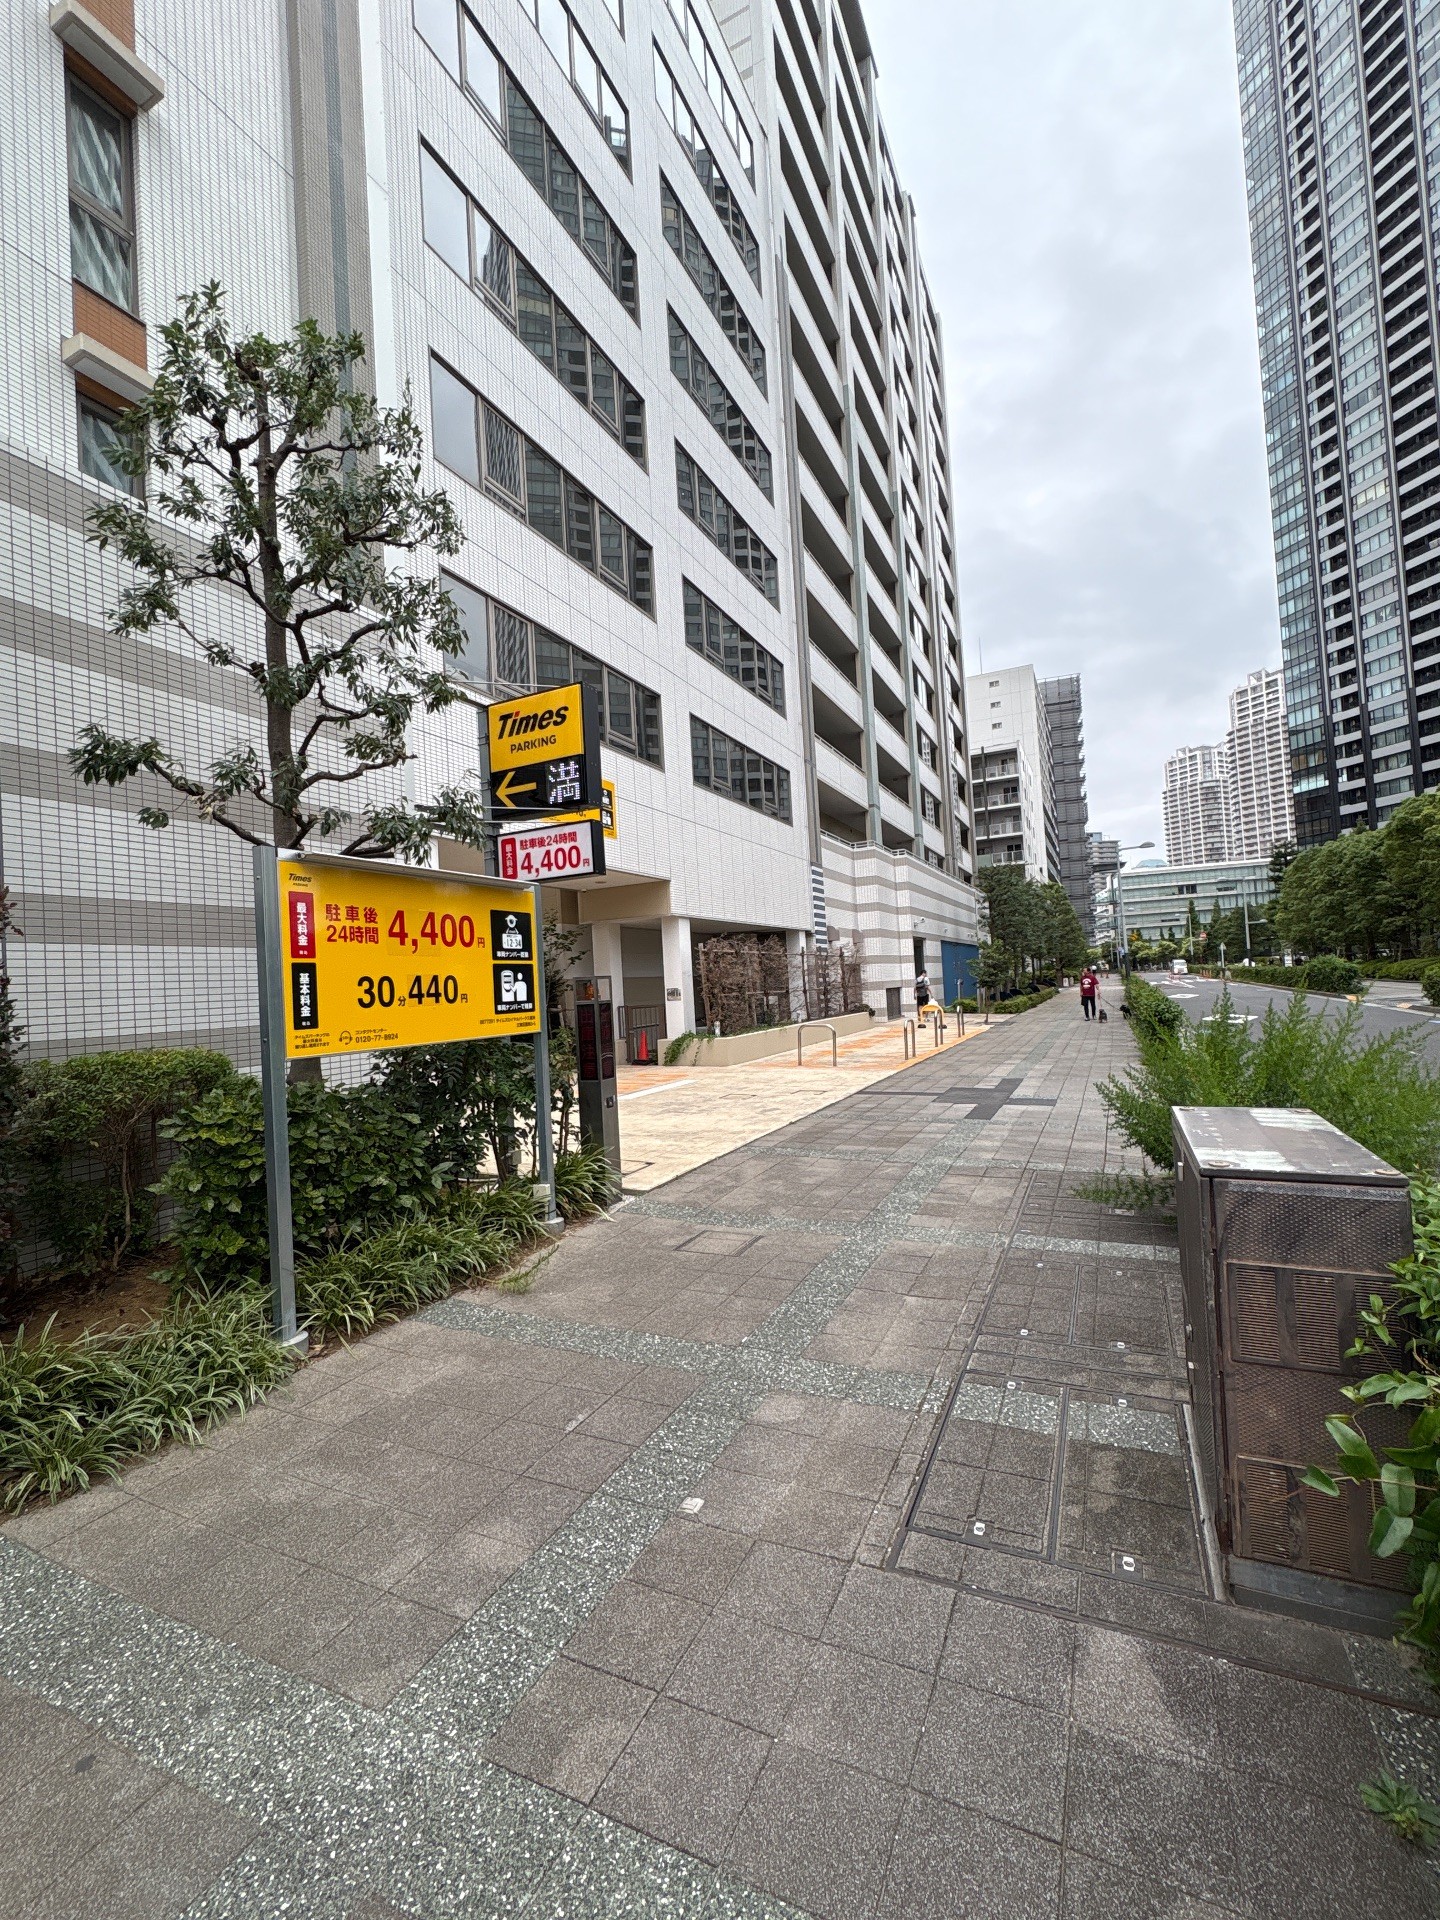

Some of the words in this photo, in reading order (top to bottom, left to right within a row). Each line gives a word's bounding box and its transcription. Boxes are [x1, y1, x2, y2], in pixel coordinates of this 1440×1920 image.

[498, 706, 569, 740] Times
[510, 735, 557, 754] PARKING
[548, 761, 580, 805] 満
[520, 831, 577, 850] 駐車後24時間
[289, 873, 312, 883] Times
[296, 901, 308, 946] 最大料金
[325, 904, 378, 924] 駐車後
[326, 925, 379, 944] 24時間
[299, 973, 311, 1017] 基本料金
[355, 1033, 399, 1043] 0120-77-8924
